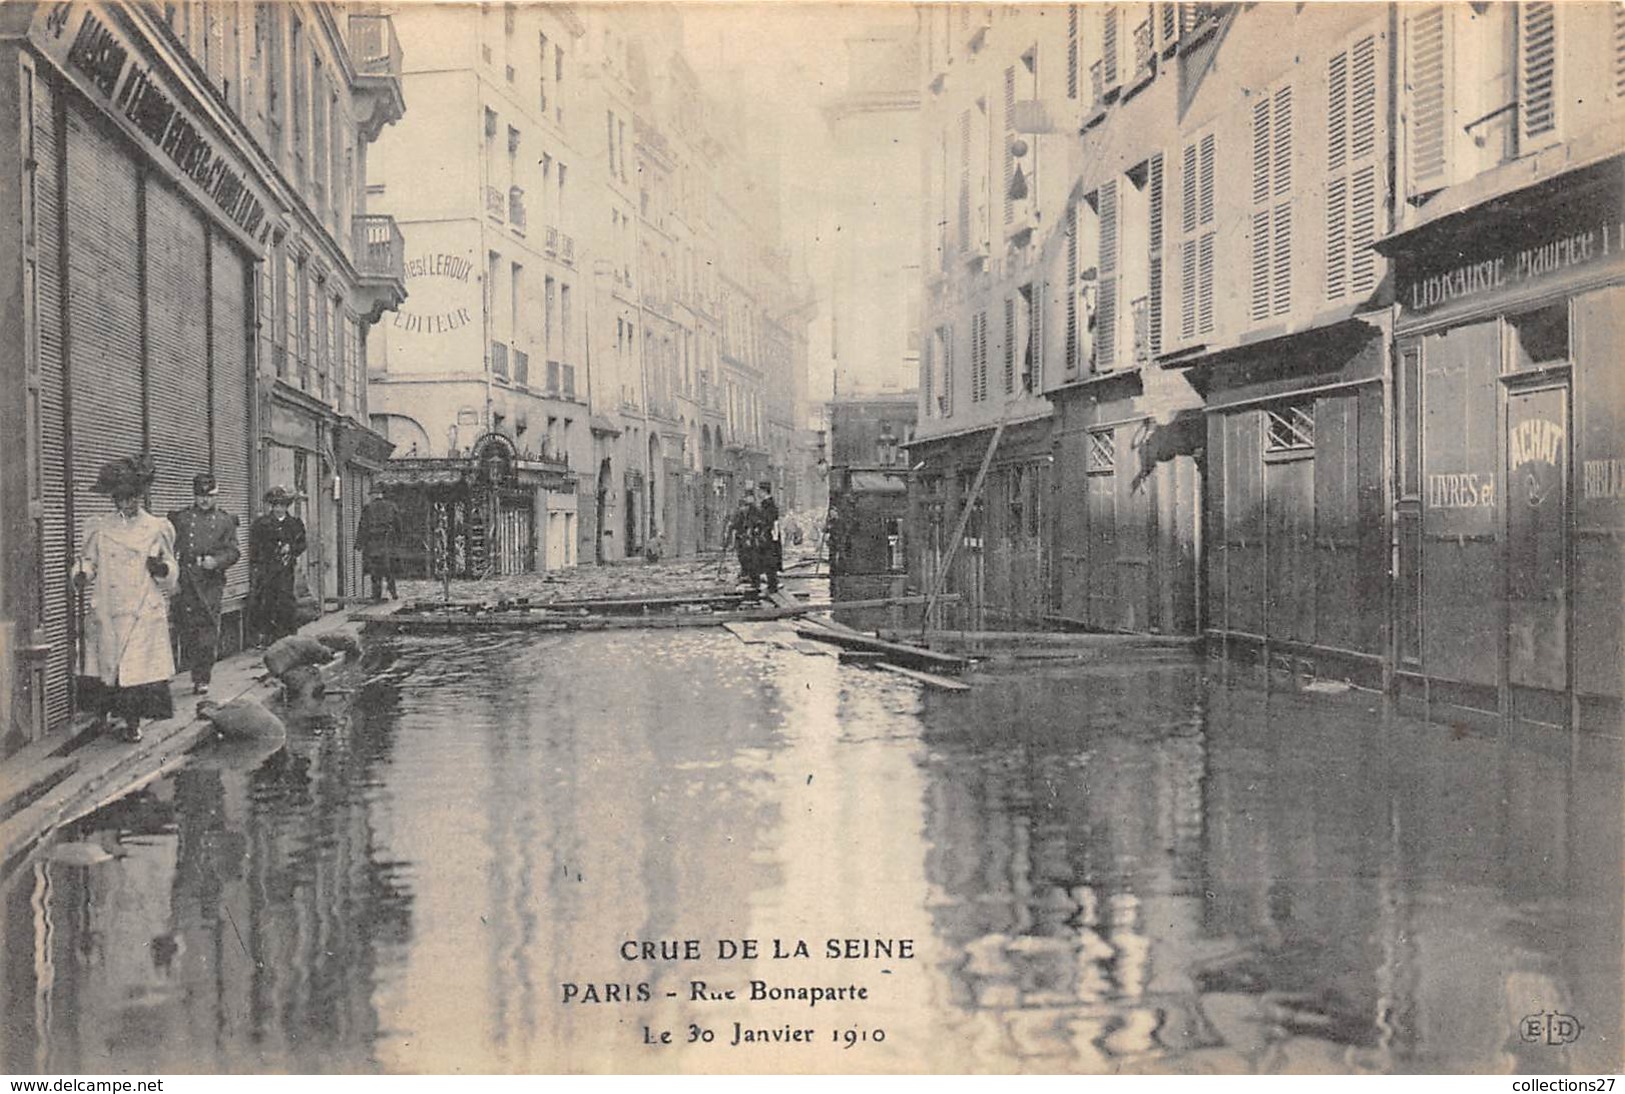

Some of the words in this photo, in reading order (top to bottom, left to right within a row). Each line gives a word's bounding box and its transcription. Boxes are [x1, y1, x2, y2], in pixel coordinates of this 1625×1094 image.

[429, 253, 473, 283] LEROUX
[1413, 255, 1506, 309] LIBRAIRIE
[1511, 419, 1562, 470] ACHAT
[1429, 474, 1477, 507] LIVRES
